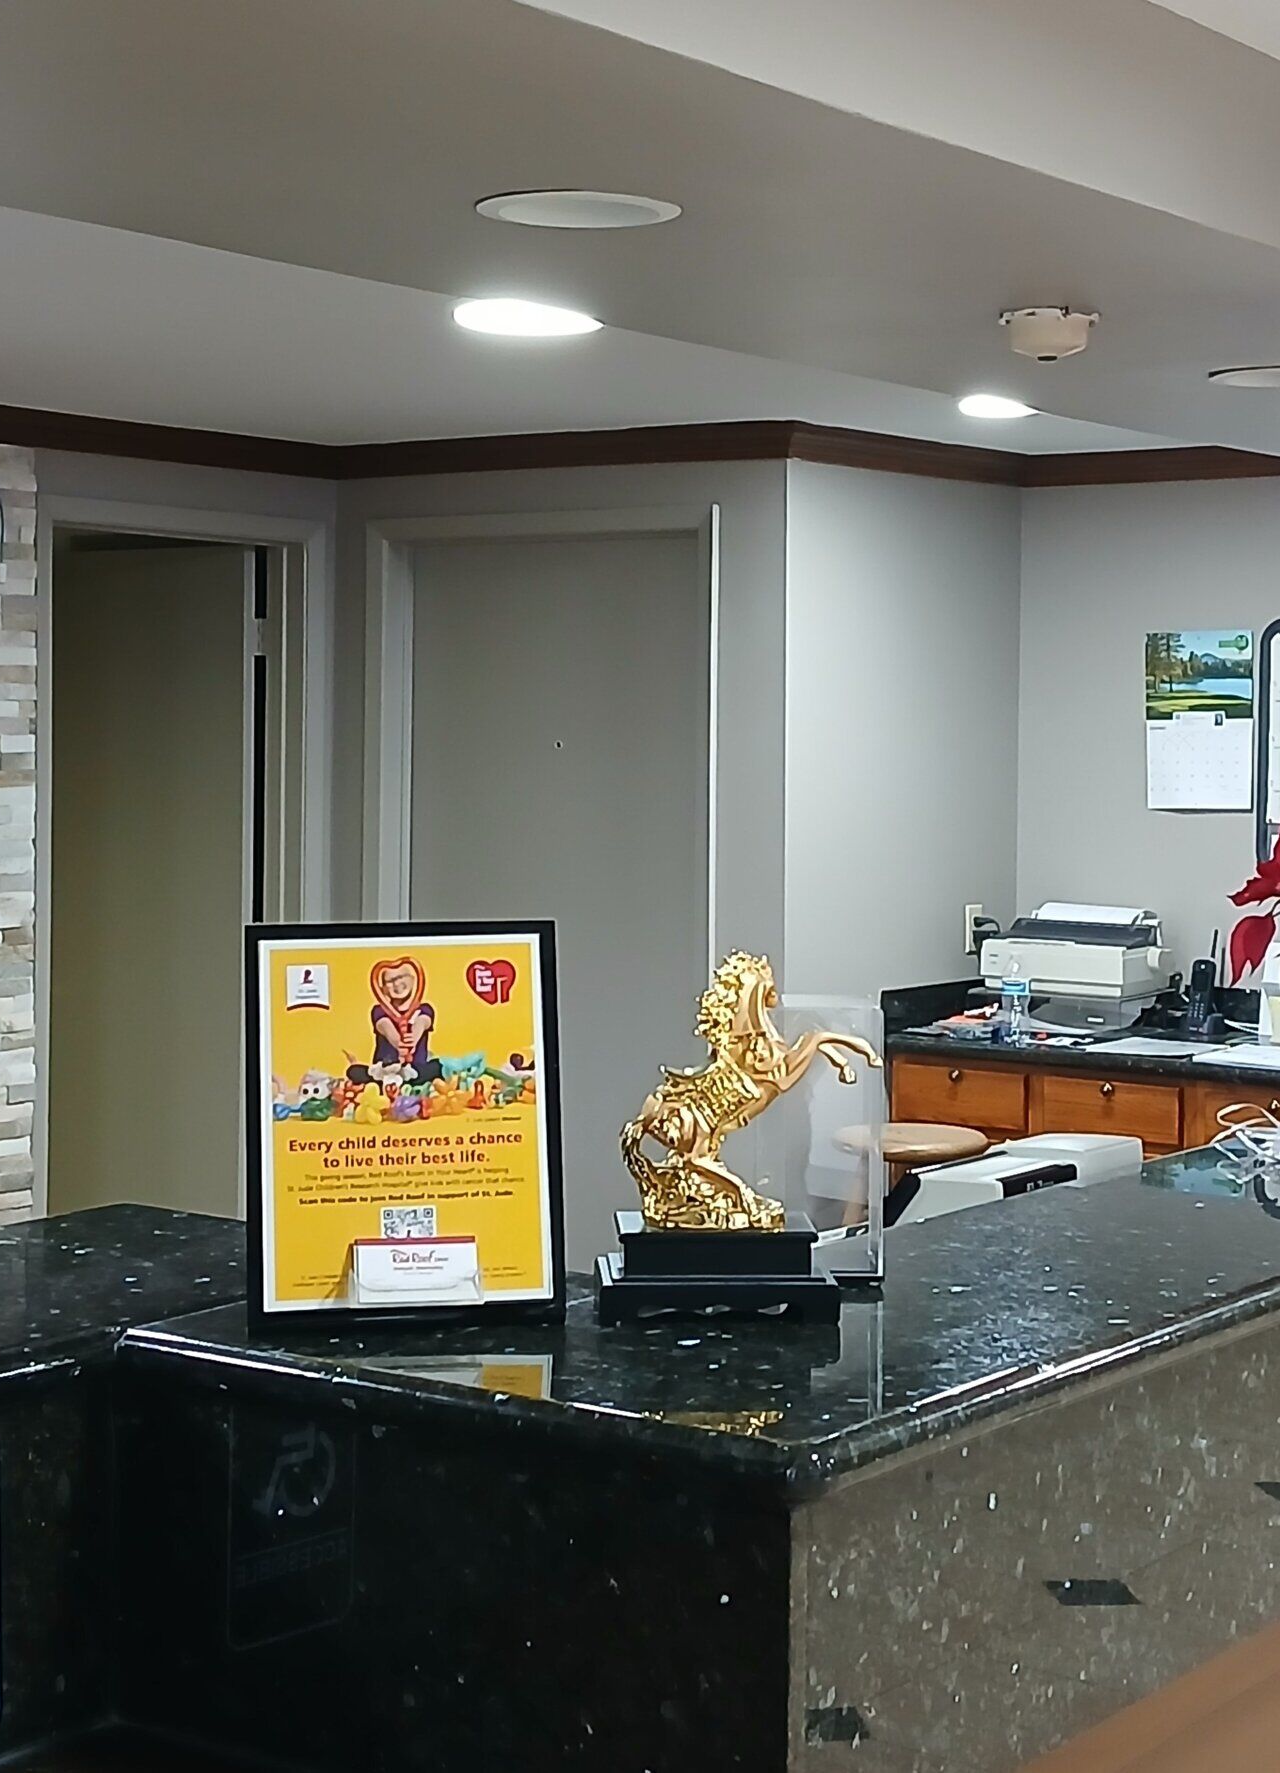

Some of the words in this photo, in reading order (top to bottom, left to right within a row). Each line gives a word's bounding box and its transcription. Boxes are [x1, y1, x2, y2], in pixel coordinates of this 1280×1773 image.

[289, 1139, 333, 1154] Every
[338, 1135, 376, 1150] child
[381, 1135, 450, 1148] deserves
[455, 1136, 464, 1146] a
[469, 1132, 522, 1145] chance
[323, 1157, 340, 1168] to
[345, 1154, 373, 1167] live
[379, 1153, 417, 1166] their
[421, 1151, 455, 1164] best
[460, 1149, 490, 1162] life.
